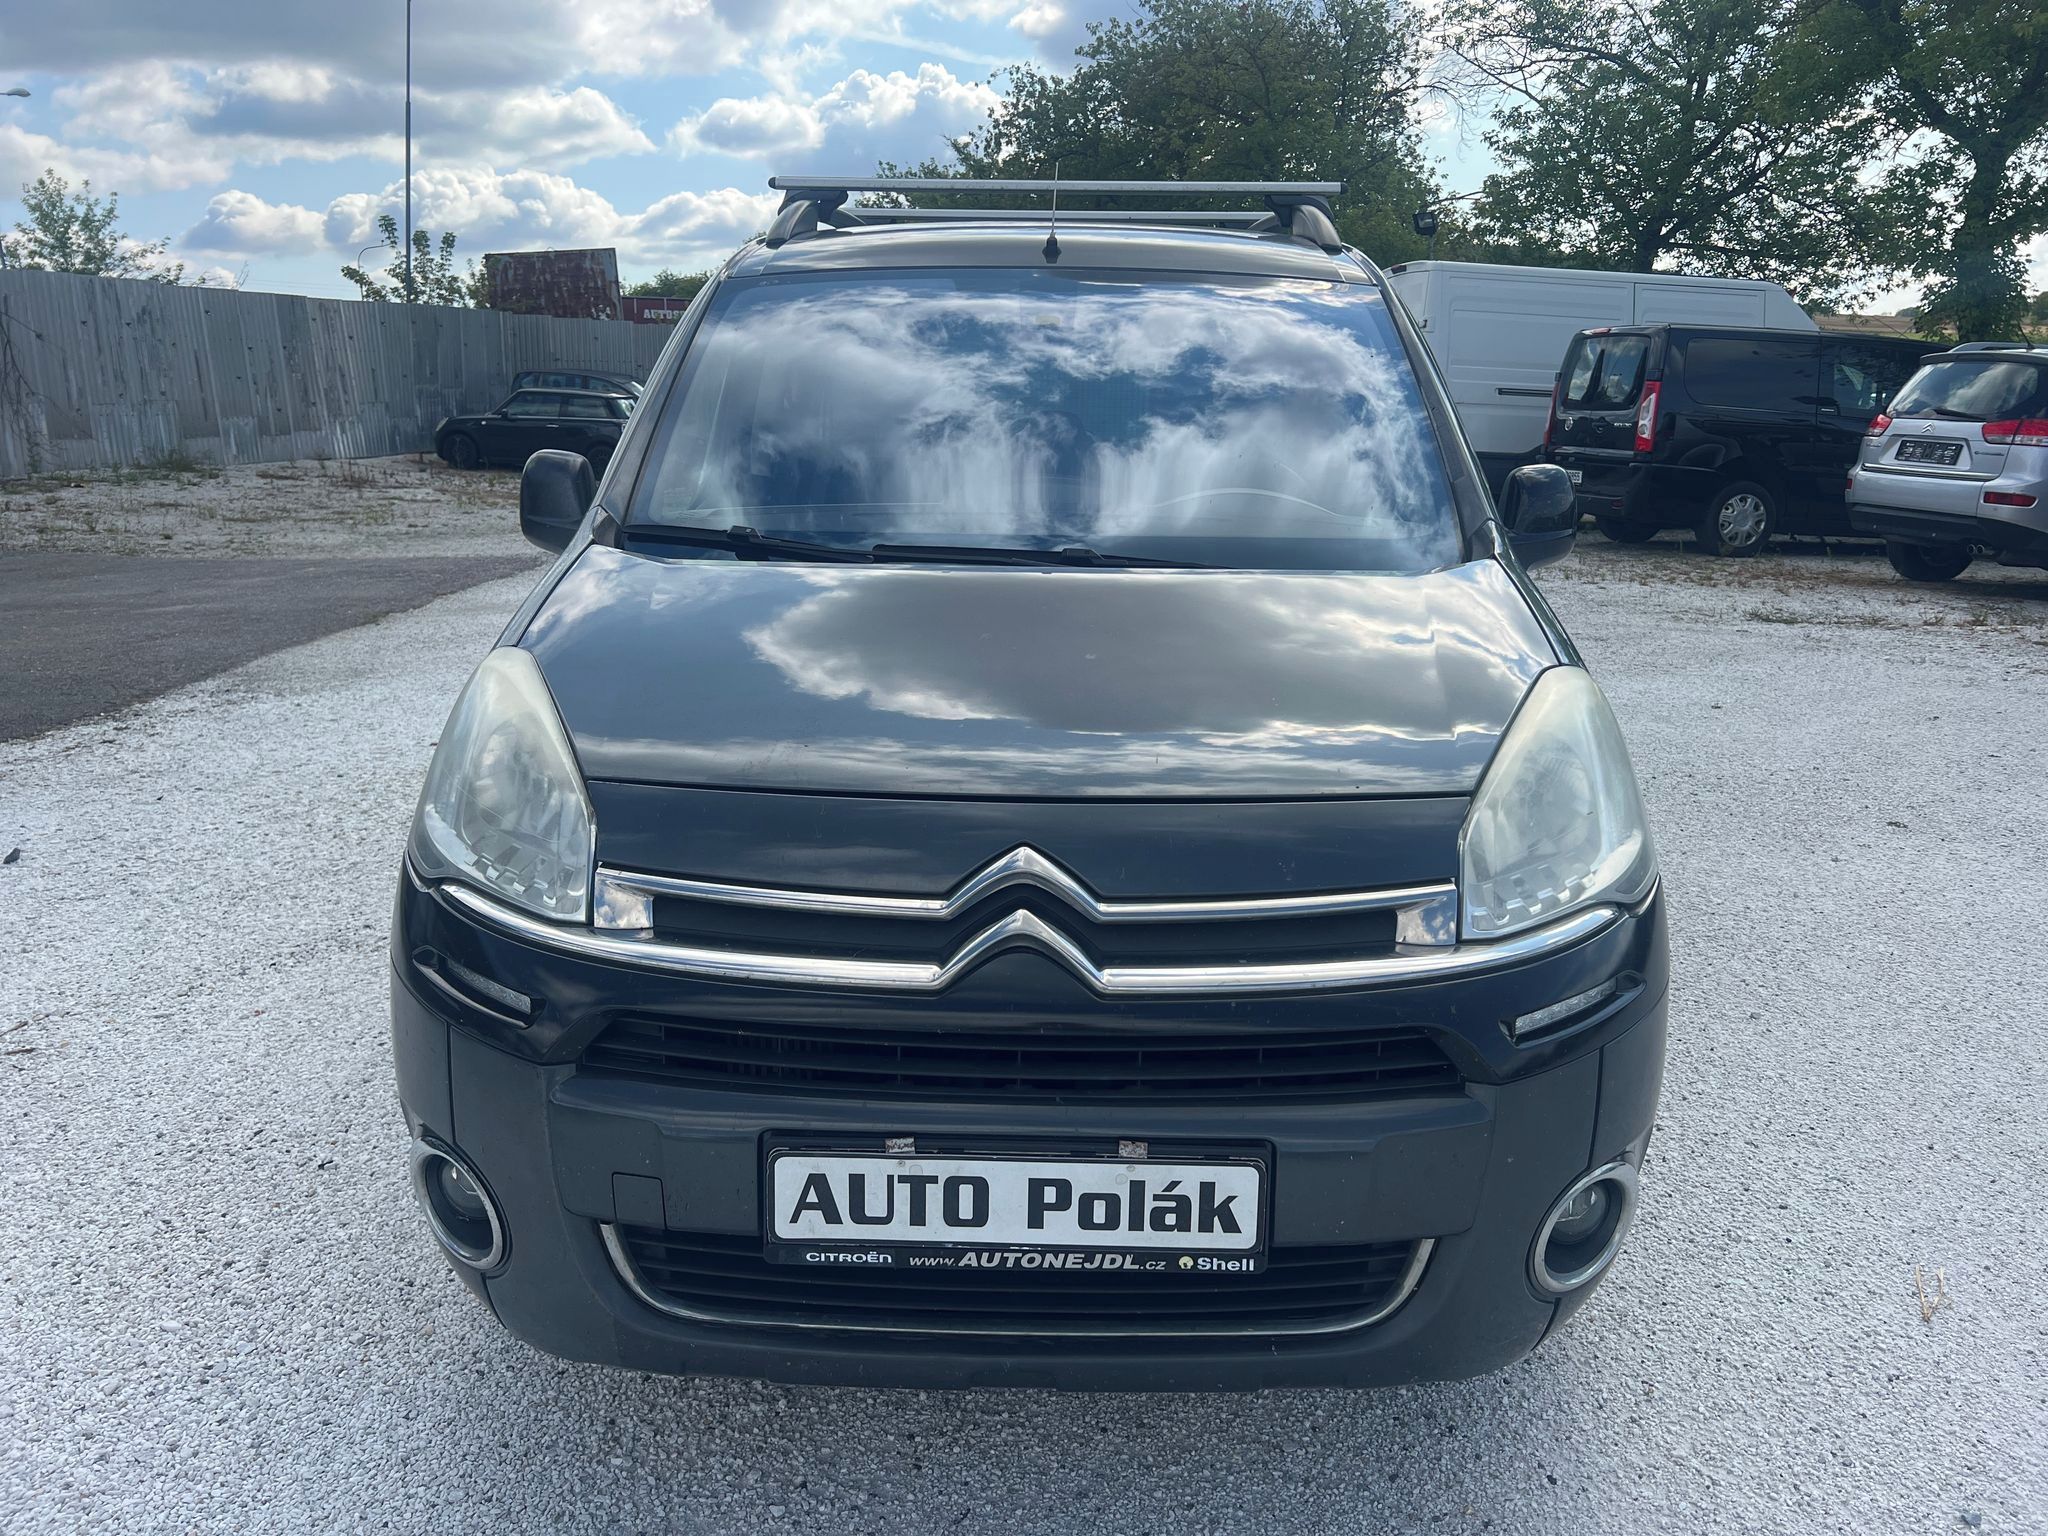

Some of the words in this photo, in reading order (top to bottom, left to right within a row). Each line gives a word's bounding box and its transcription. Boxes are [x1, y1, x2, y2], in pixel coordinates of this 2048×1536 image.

[789, 1173, 990, 1227] AUTO
[1027, 1178, 1242, 1234] Polák
[909, 1252, 1166, 1270] www.AUTONEJDL.cz
[1197, 1257, 1255, 1271] Shell
